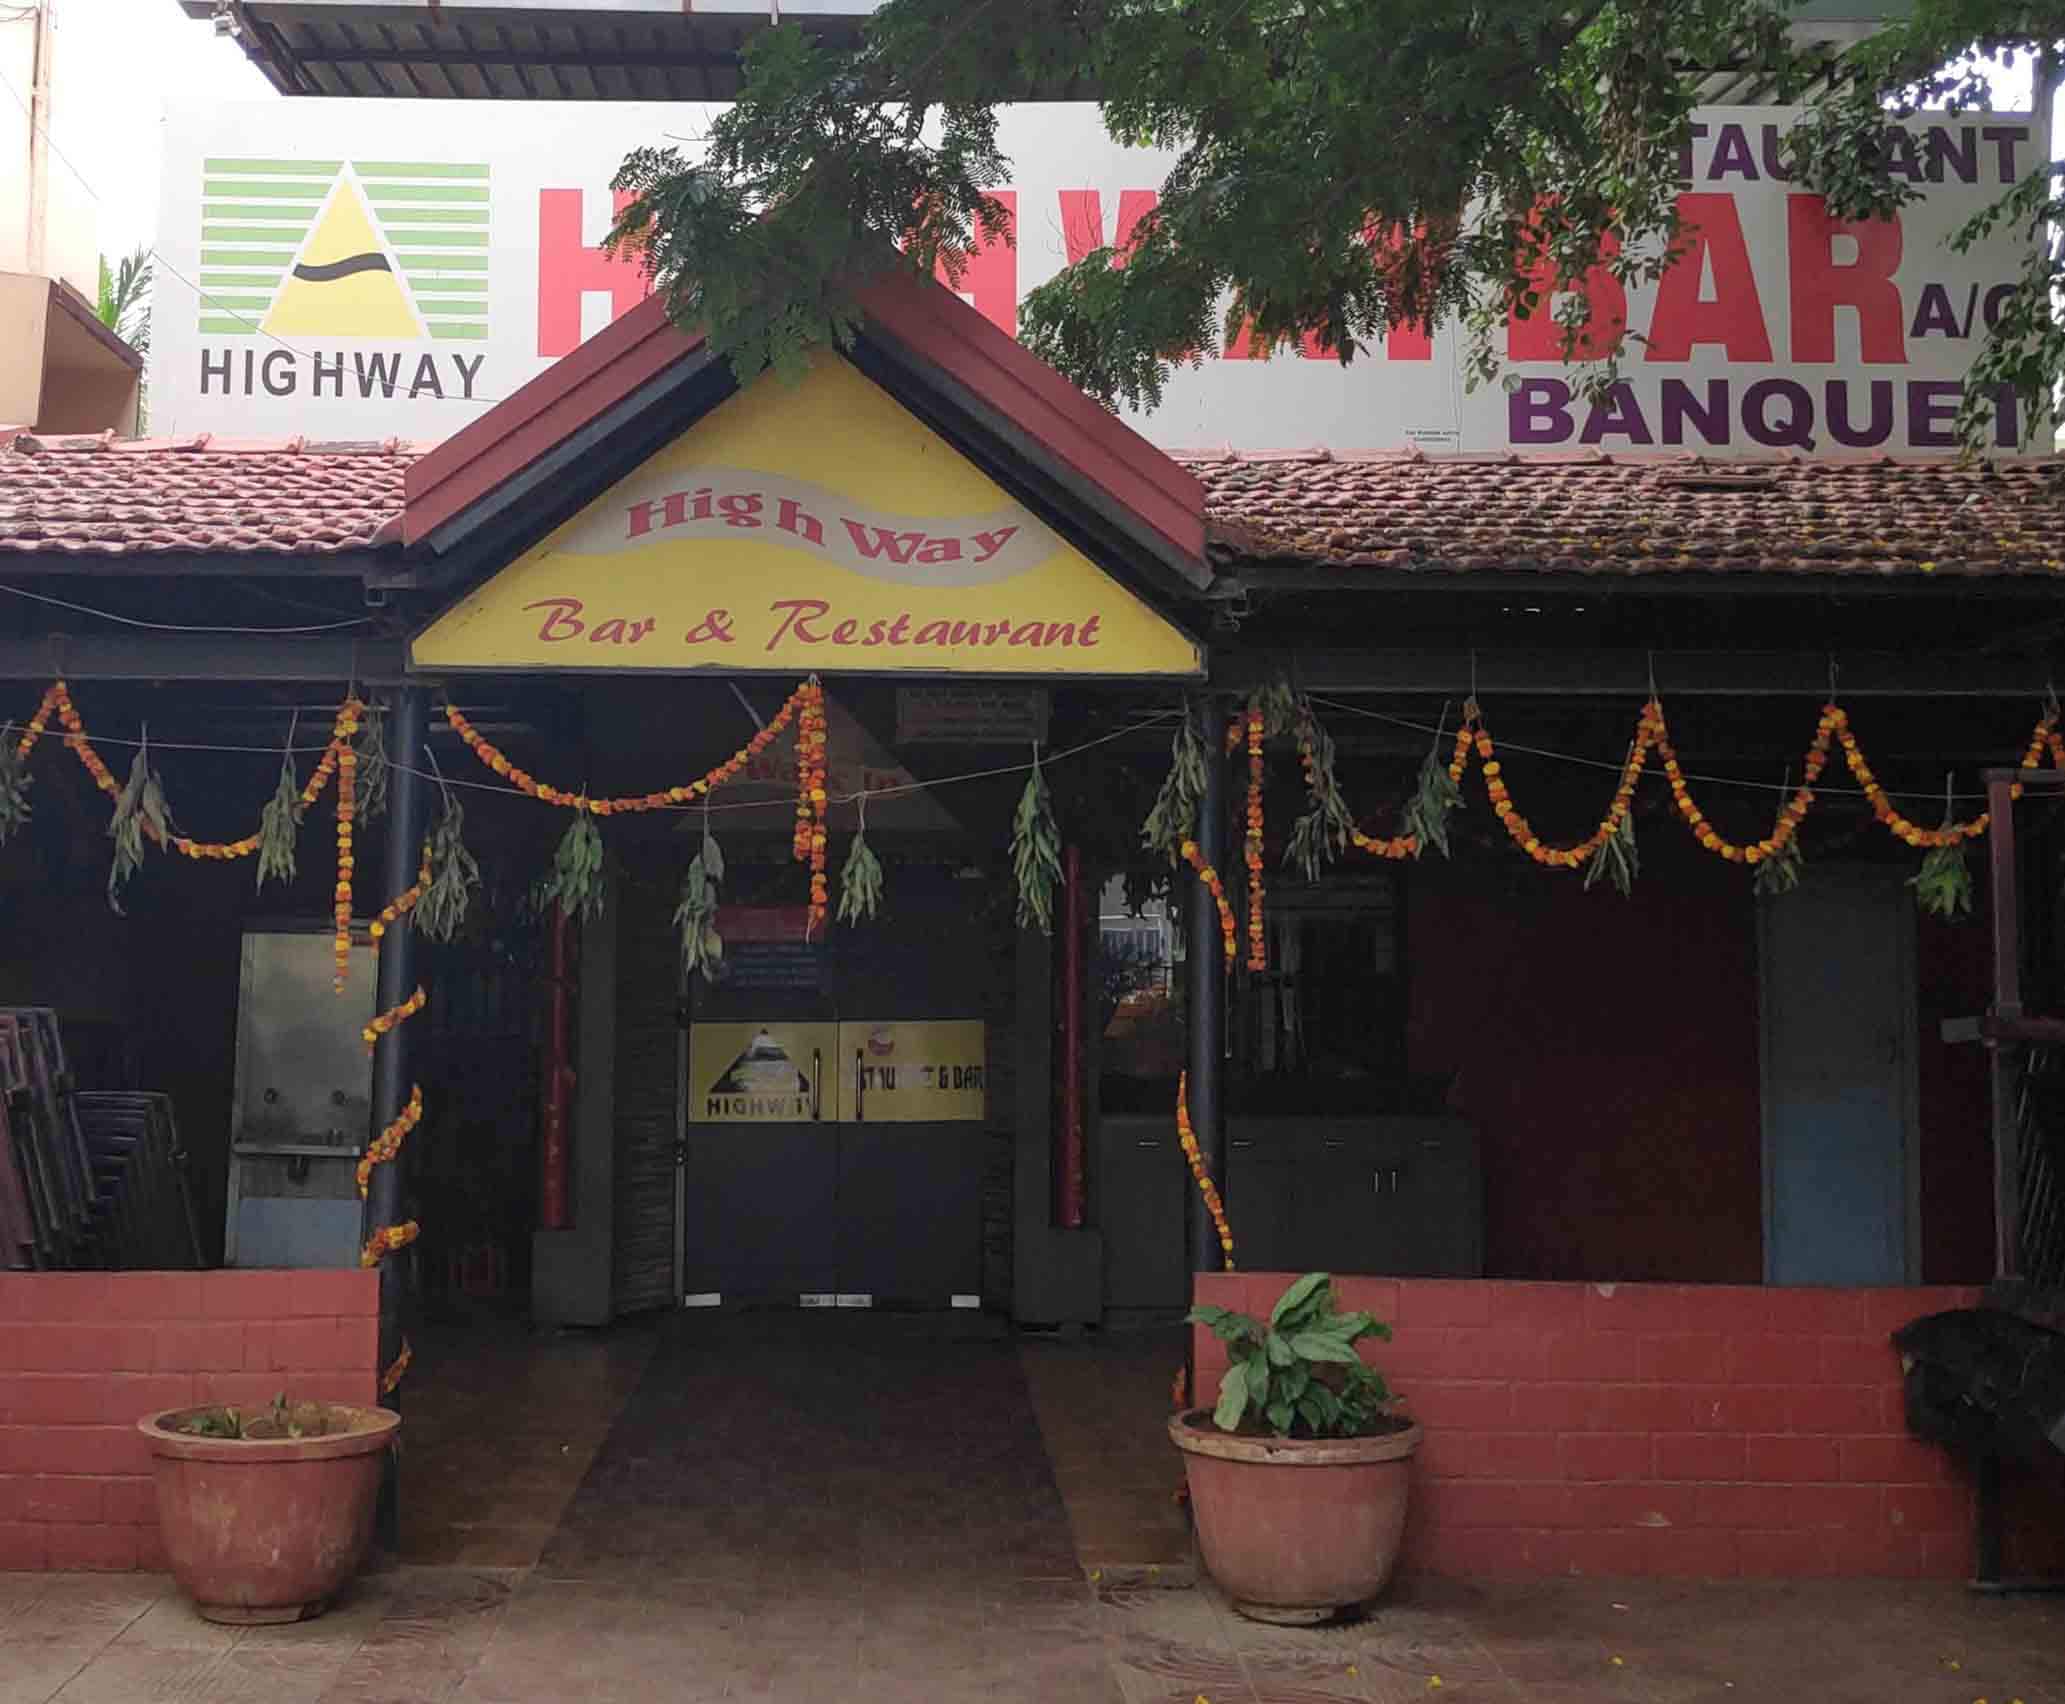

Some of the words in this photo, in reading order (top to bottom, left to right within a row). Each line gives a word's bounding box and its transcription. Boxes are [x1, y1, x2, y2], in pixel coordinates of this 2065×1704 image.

[1507, 192, 1909, 365] BAR
[199, 348, 486, 400] HIGHWAY
[521, 597, 655, 644] Bar
[686, 608, 736, 643] &
[766, 599, 1101, 651] Restaurant
